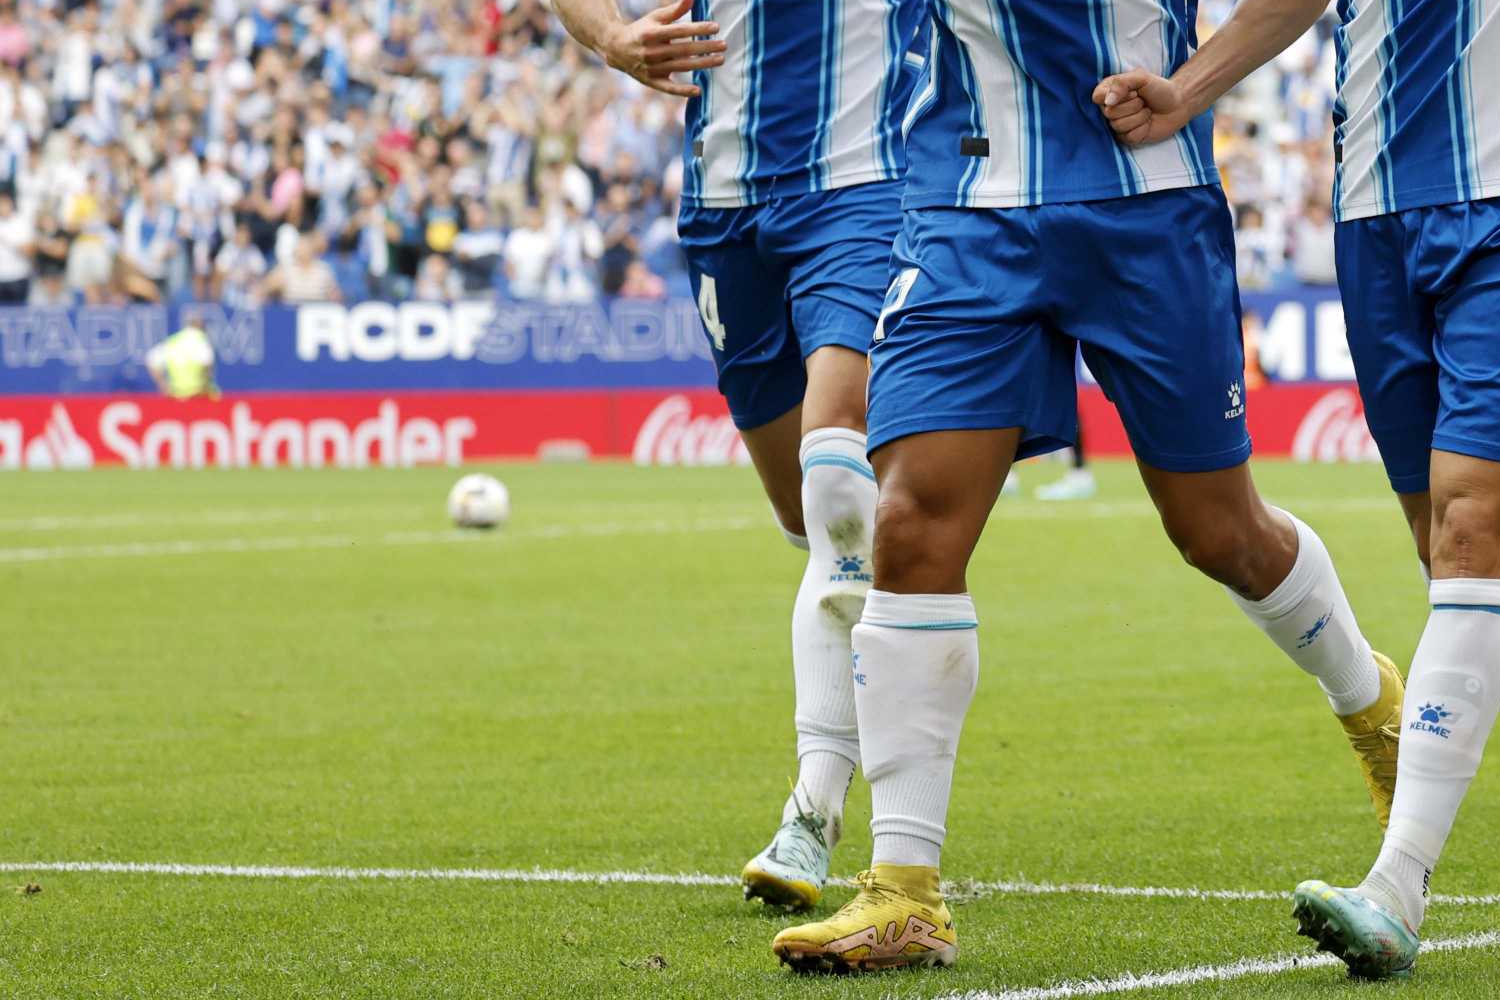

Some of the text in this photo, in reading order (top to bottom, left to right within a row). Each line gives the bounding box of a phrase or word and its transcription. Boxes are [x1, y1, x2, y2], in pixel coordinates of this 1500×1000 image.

[698, 273, 726, 351] 4
[99, 402, 477, 468] Santander
[1409, 721, 1451, 740] KELME
